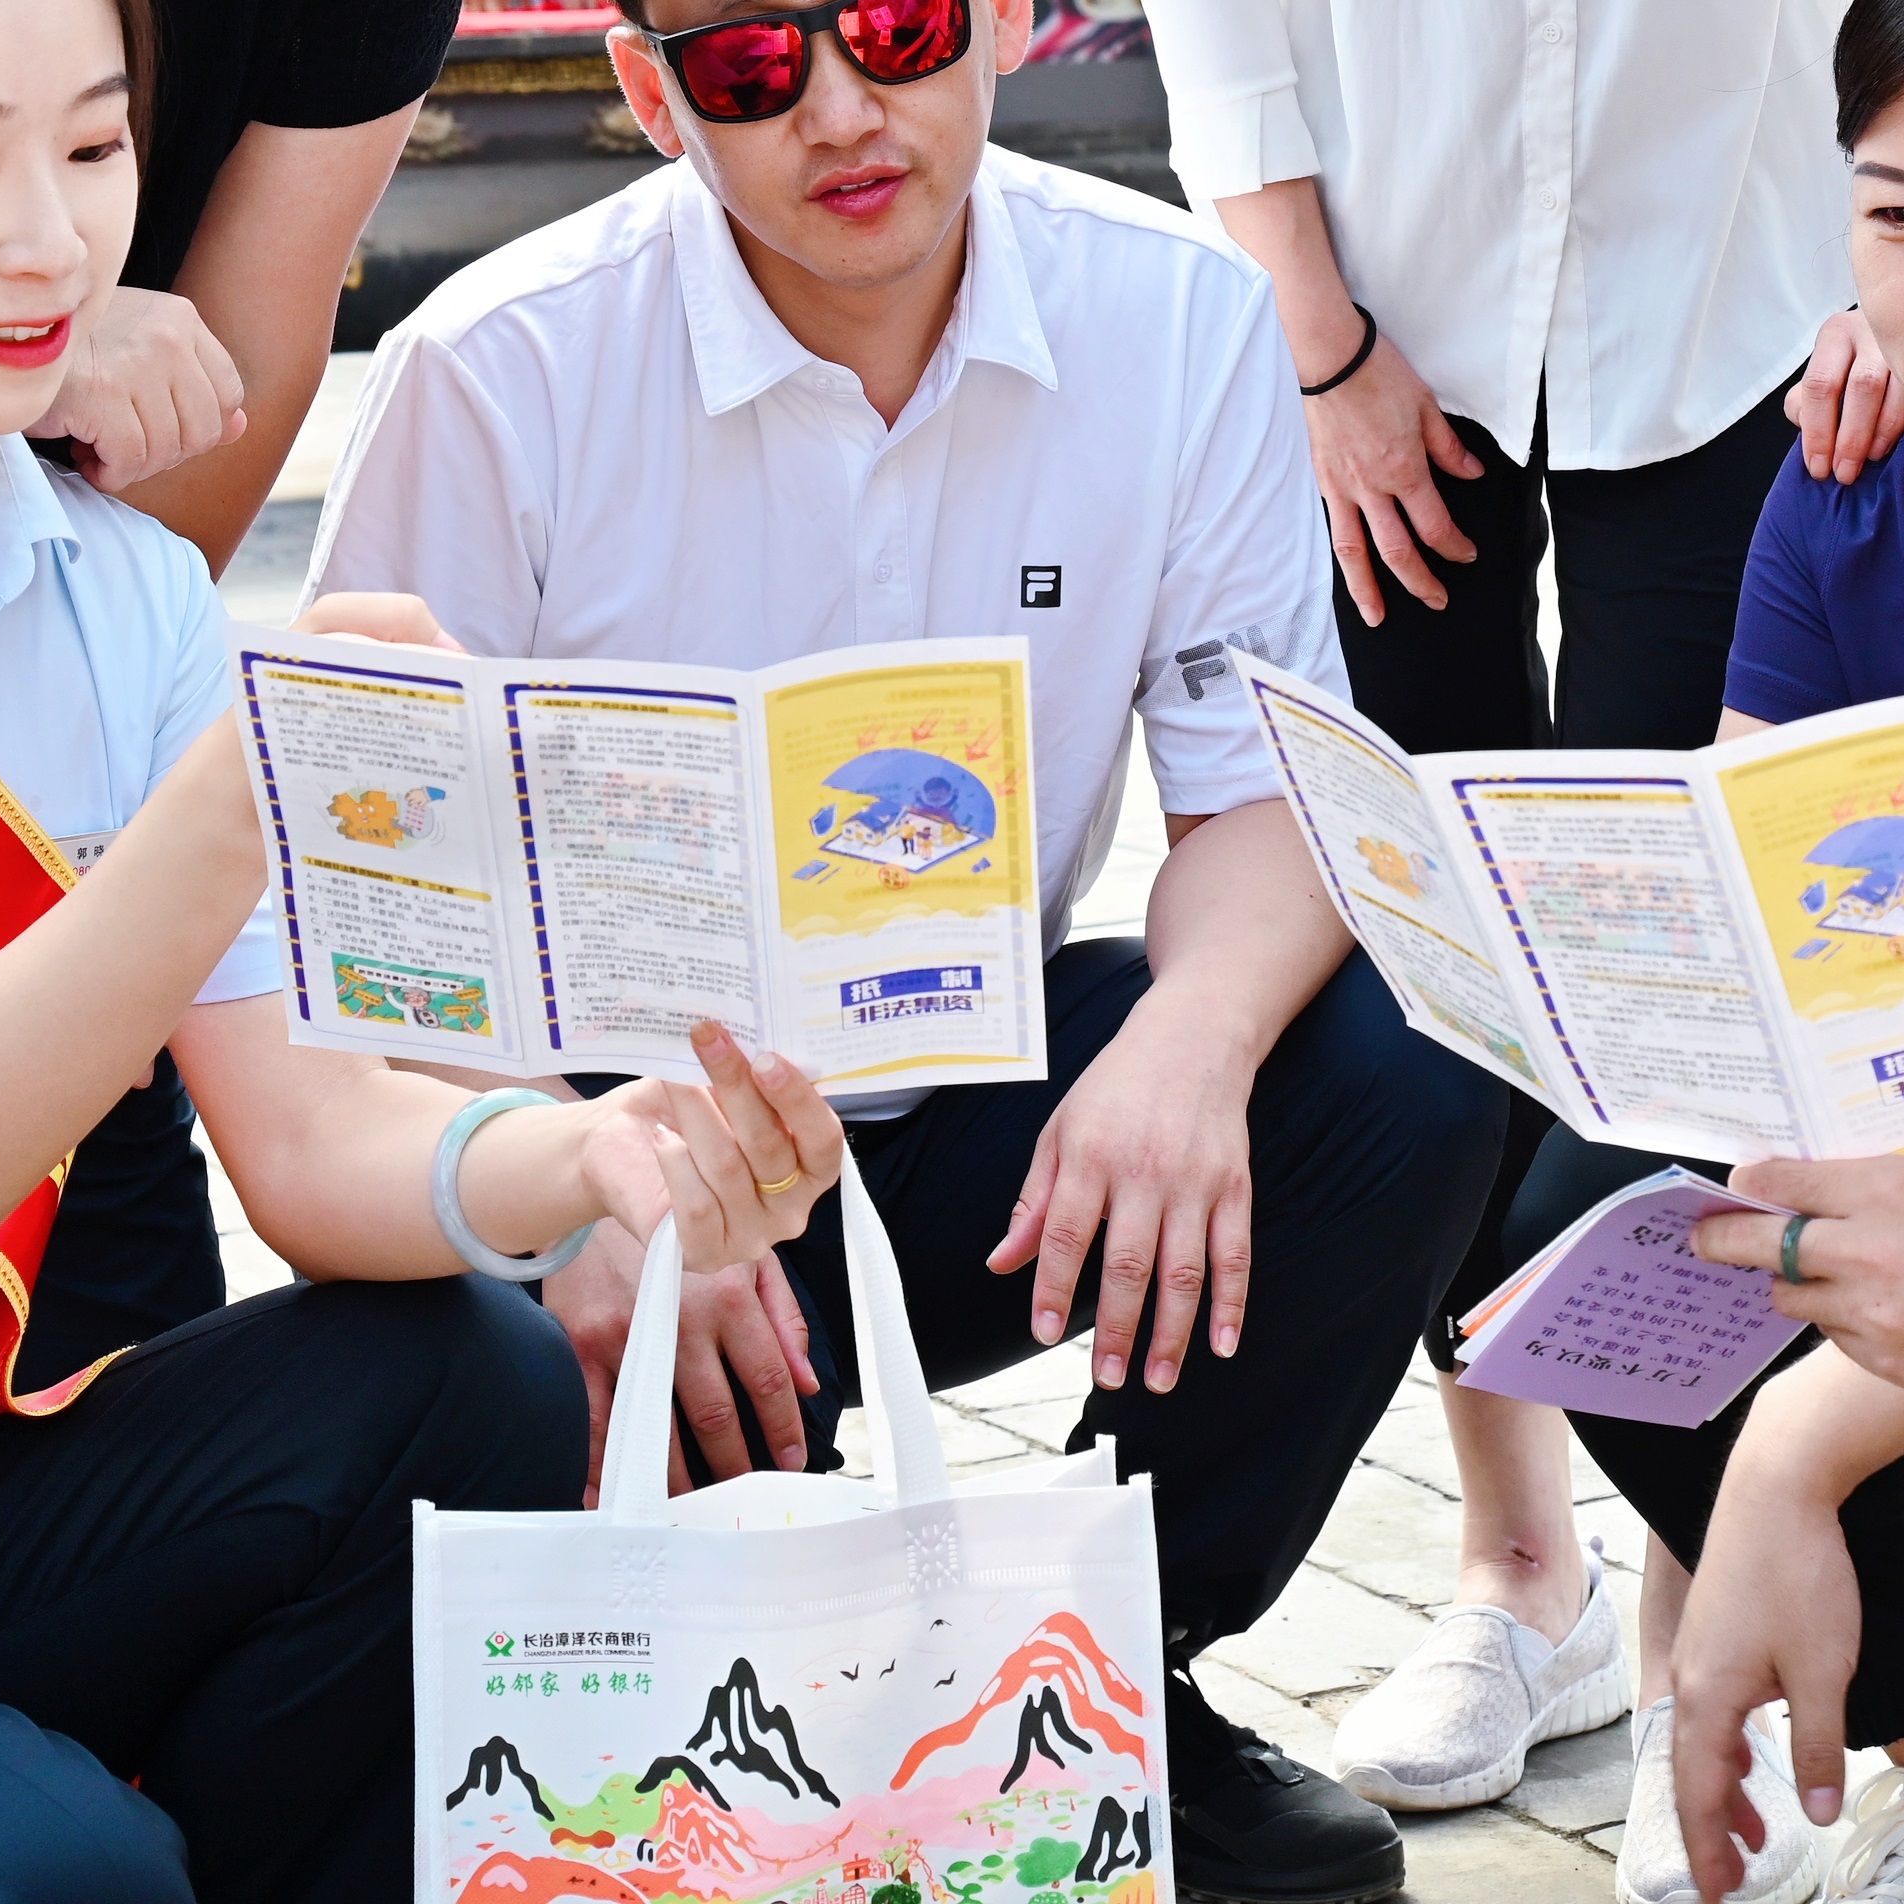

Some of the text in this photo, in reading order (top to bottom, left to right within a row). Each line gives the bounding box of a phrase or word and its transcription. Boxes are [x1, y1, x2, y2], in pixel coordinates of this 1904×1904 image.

[853, 994, 974, 1024] 非法集资
[1523, 1339, 1704, 1388] 千万不要以为
[523, 1631, 651, 1648] 长治漳泽农商银行
[485, 1670, 653, 1698] 好邻家 好银行
